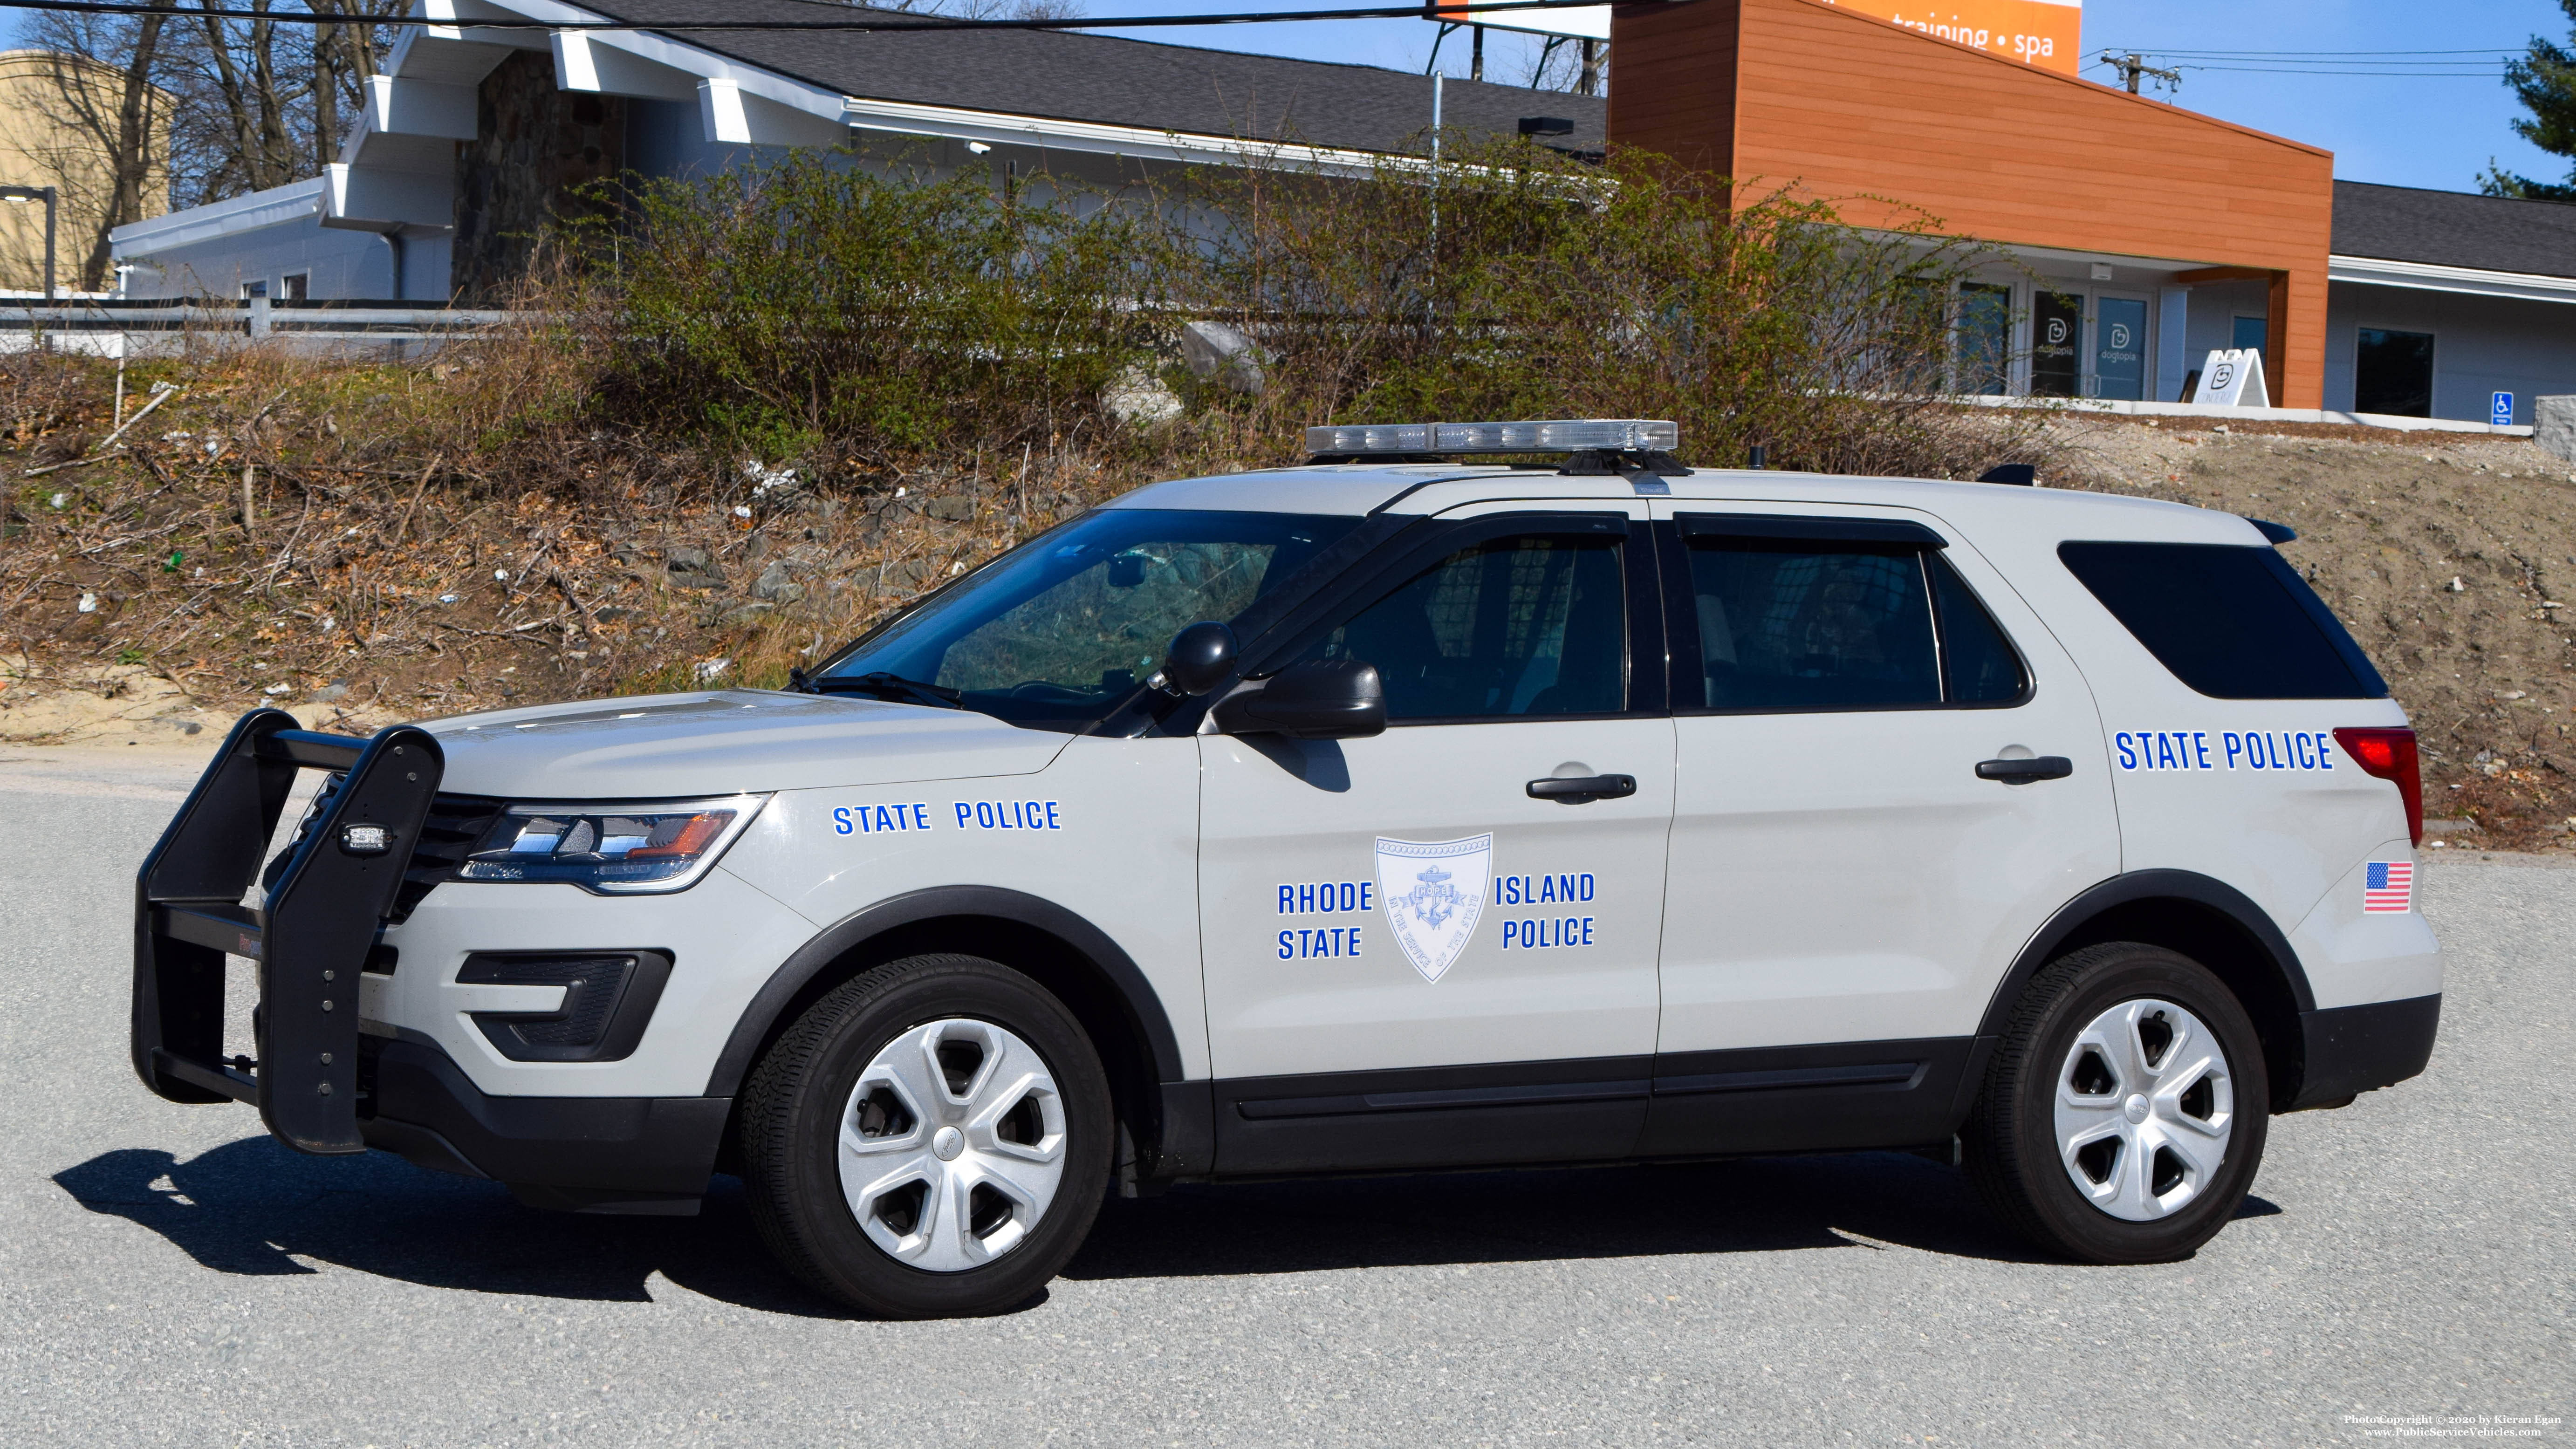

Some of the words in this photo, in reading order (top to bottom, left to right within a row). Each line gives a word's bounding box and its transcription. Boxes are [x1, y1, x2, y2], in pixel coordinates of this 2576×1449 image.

[2015, 33, 2054, 63] spa
[2102, 349, 2137, 363] dogtopia
[2115, 731, 2213, 770] STATE
[2222, 731, 2334, 770] POLICE
[832, 803, 931, 835] STATE
[954, 800, 1061, 830] POLICE
[1278, 881, 1373, 914] RHODE
[1388, 895, 1399, 909] IN
[1420, 886, 1447, 895] HOPE
[1495, 873, 1595, 905] ISLAND
[1393, 909, 1407, 932] THE
[1461, 894, 1480, 929] STATE
[1278, 927, 1361, 960] STATE
[1447, 930, 1464, 951] THE
[1502, 916, 1594, 949] POLICE
[1403, 931, 1432, 969] SERVICE
[1435, 951, 1447, 967] OF
[944, 1134, 955, 1153] Ford
